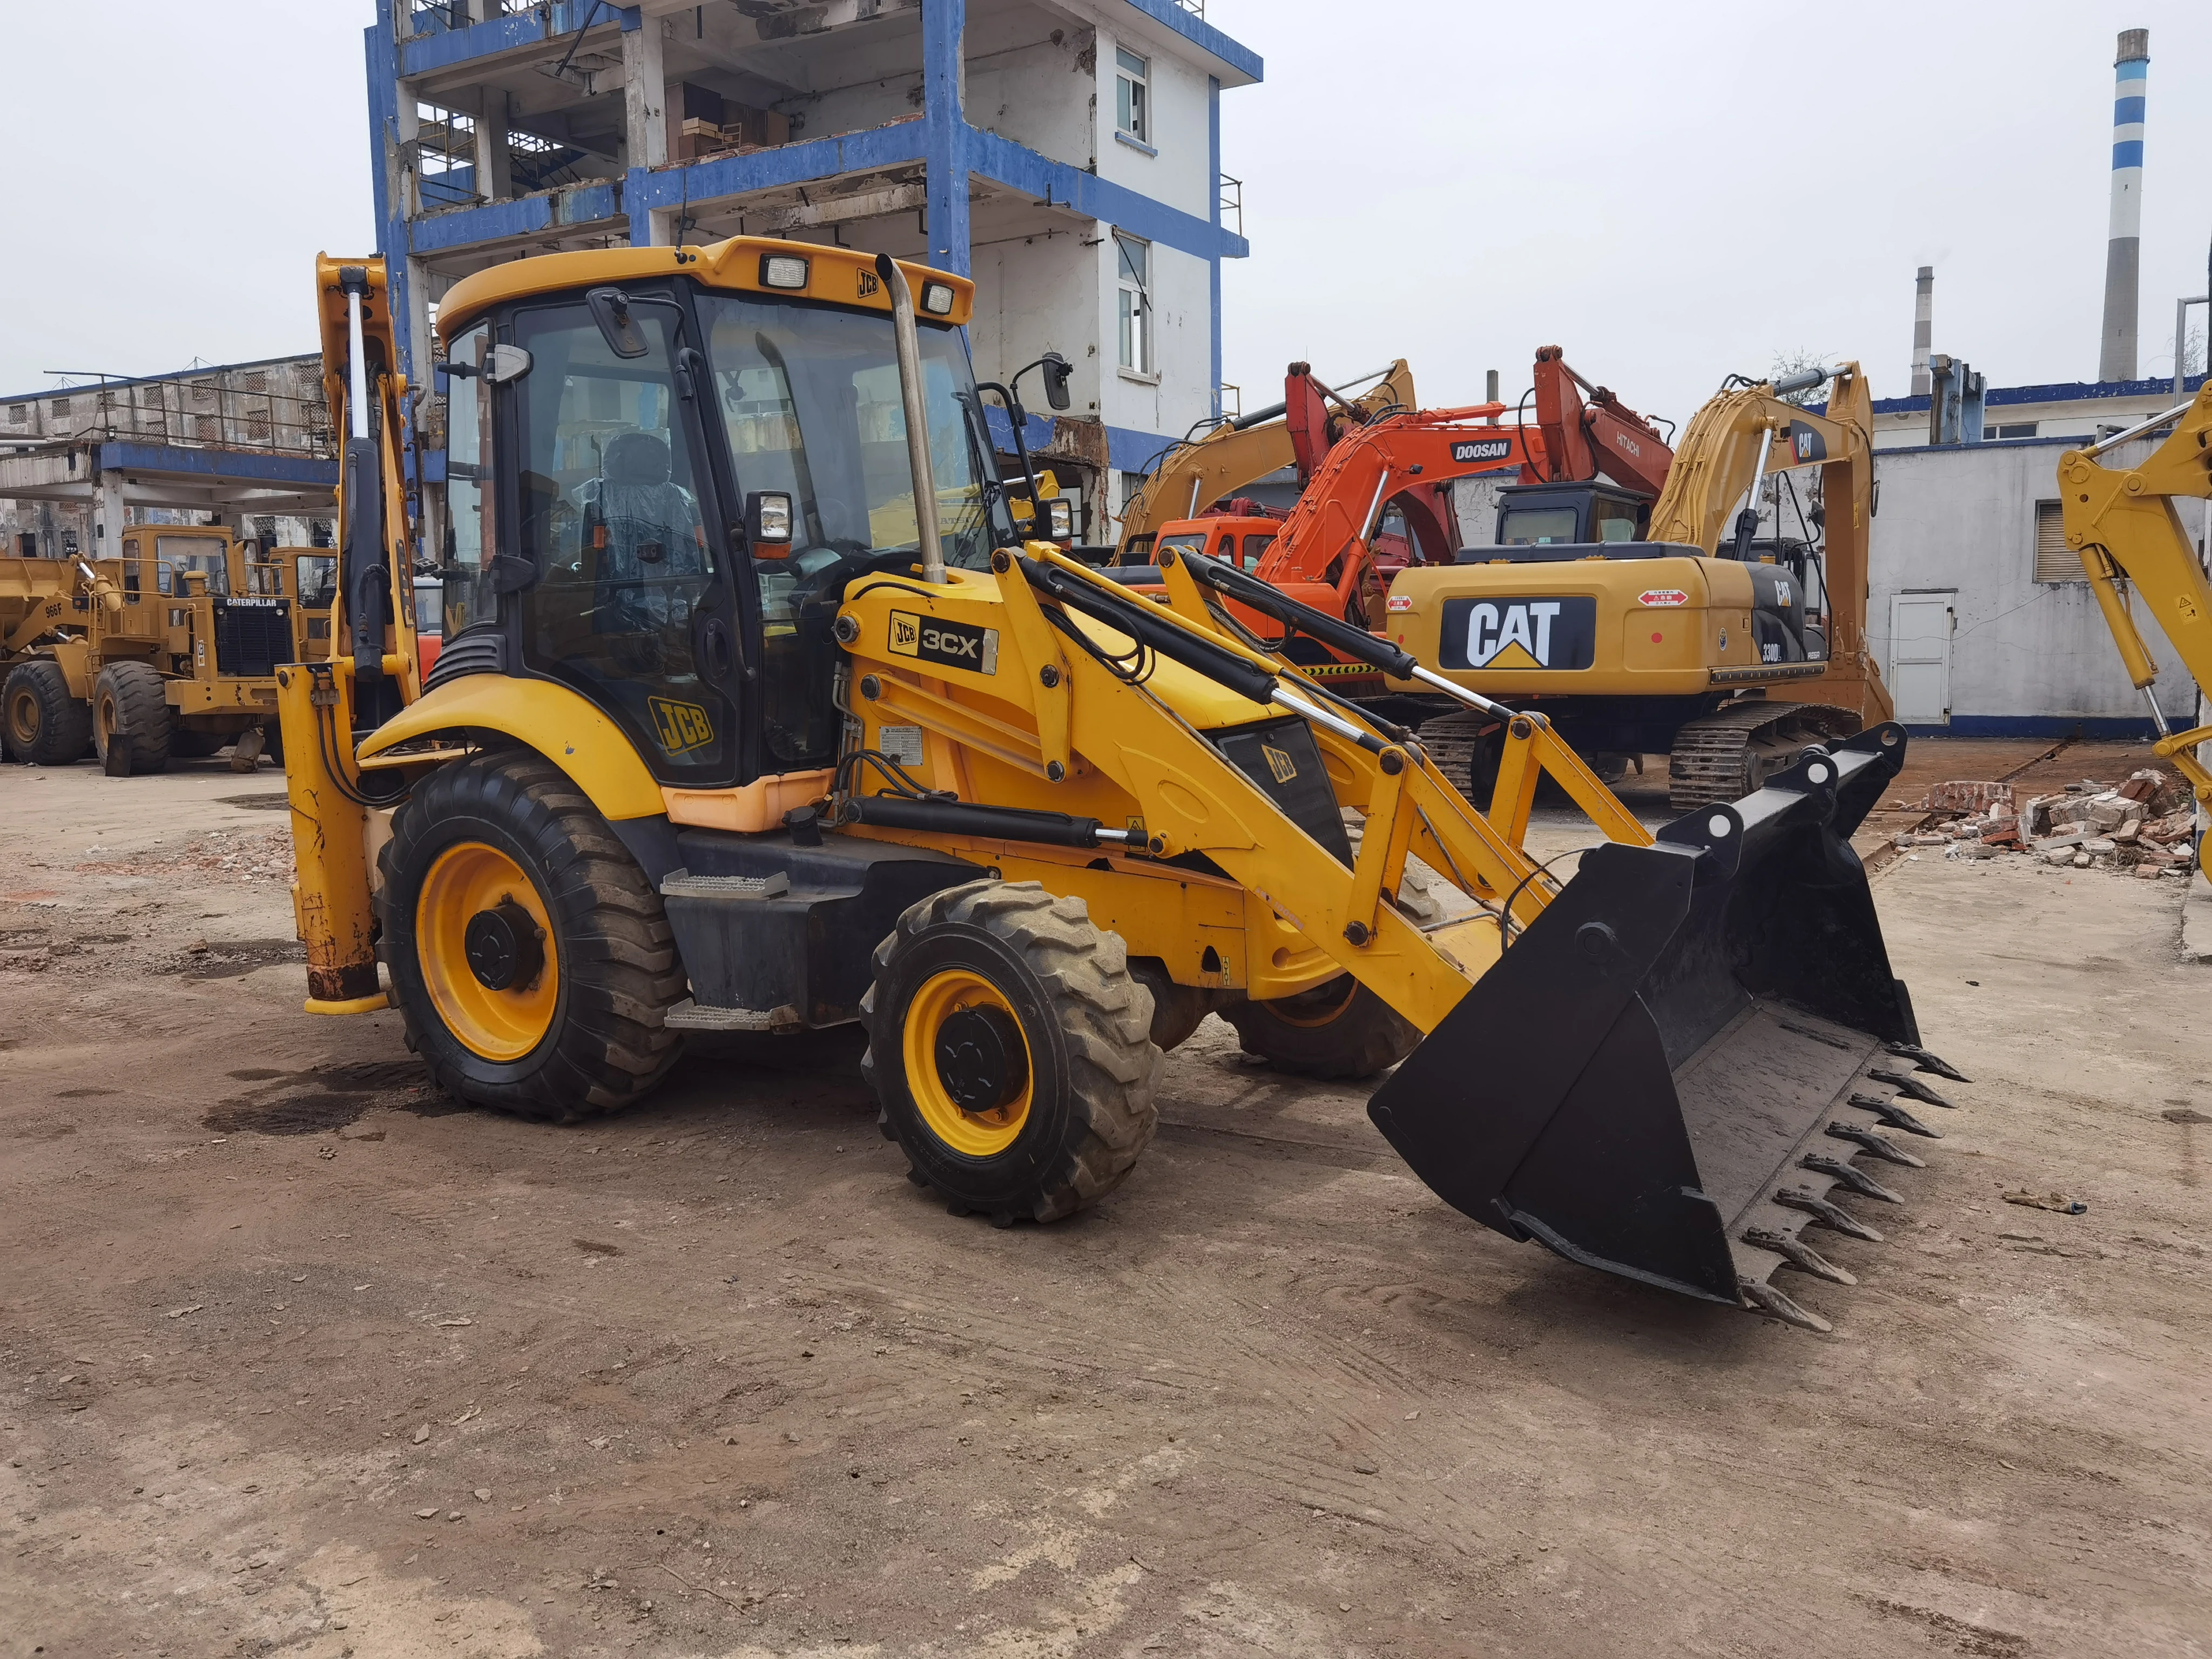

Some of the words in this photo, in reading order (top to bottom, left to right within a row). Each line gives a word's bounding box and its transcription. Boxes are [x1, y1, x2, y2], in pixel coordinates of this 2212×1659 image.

[859, 271, 878, 295] JCB
[1455, 442, 1507, 460] DOOSAN
[1616, 430, 1640, 458] HITACHI
[1799, 433, 1812, 458] CAT
[911, 516, 973, 526] KATSU
[226, 598, 277, 607] CATERPILLAR
[1774, 580, 1791, 607] CAT
[45, 602, 62, 618] 966F
[897, 621, 915, 643] JCB
[922, 629, 979, 659] 3CX
[1466, 602, 1561, 667] CAT
[659, 703, 709, 750] JCB
[1266, 747, 1294, 780] JCB
